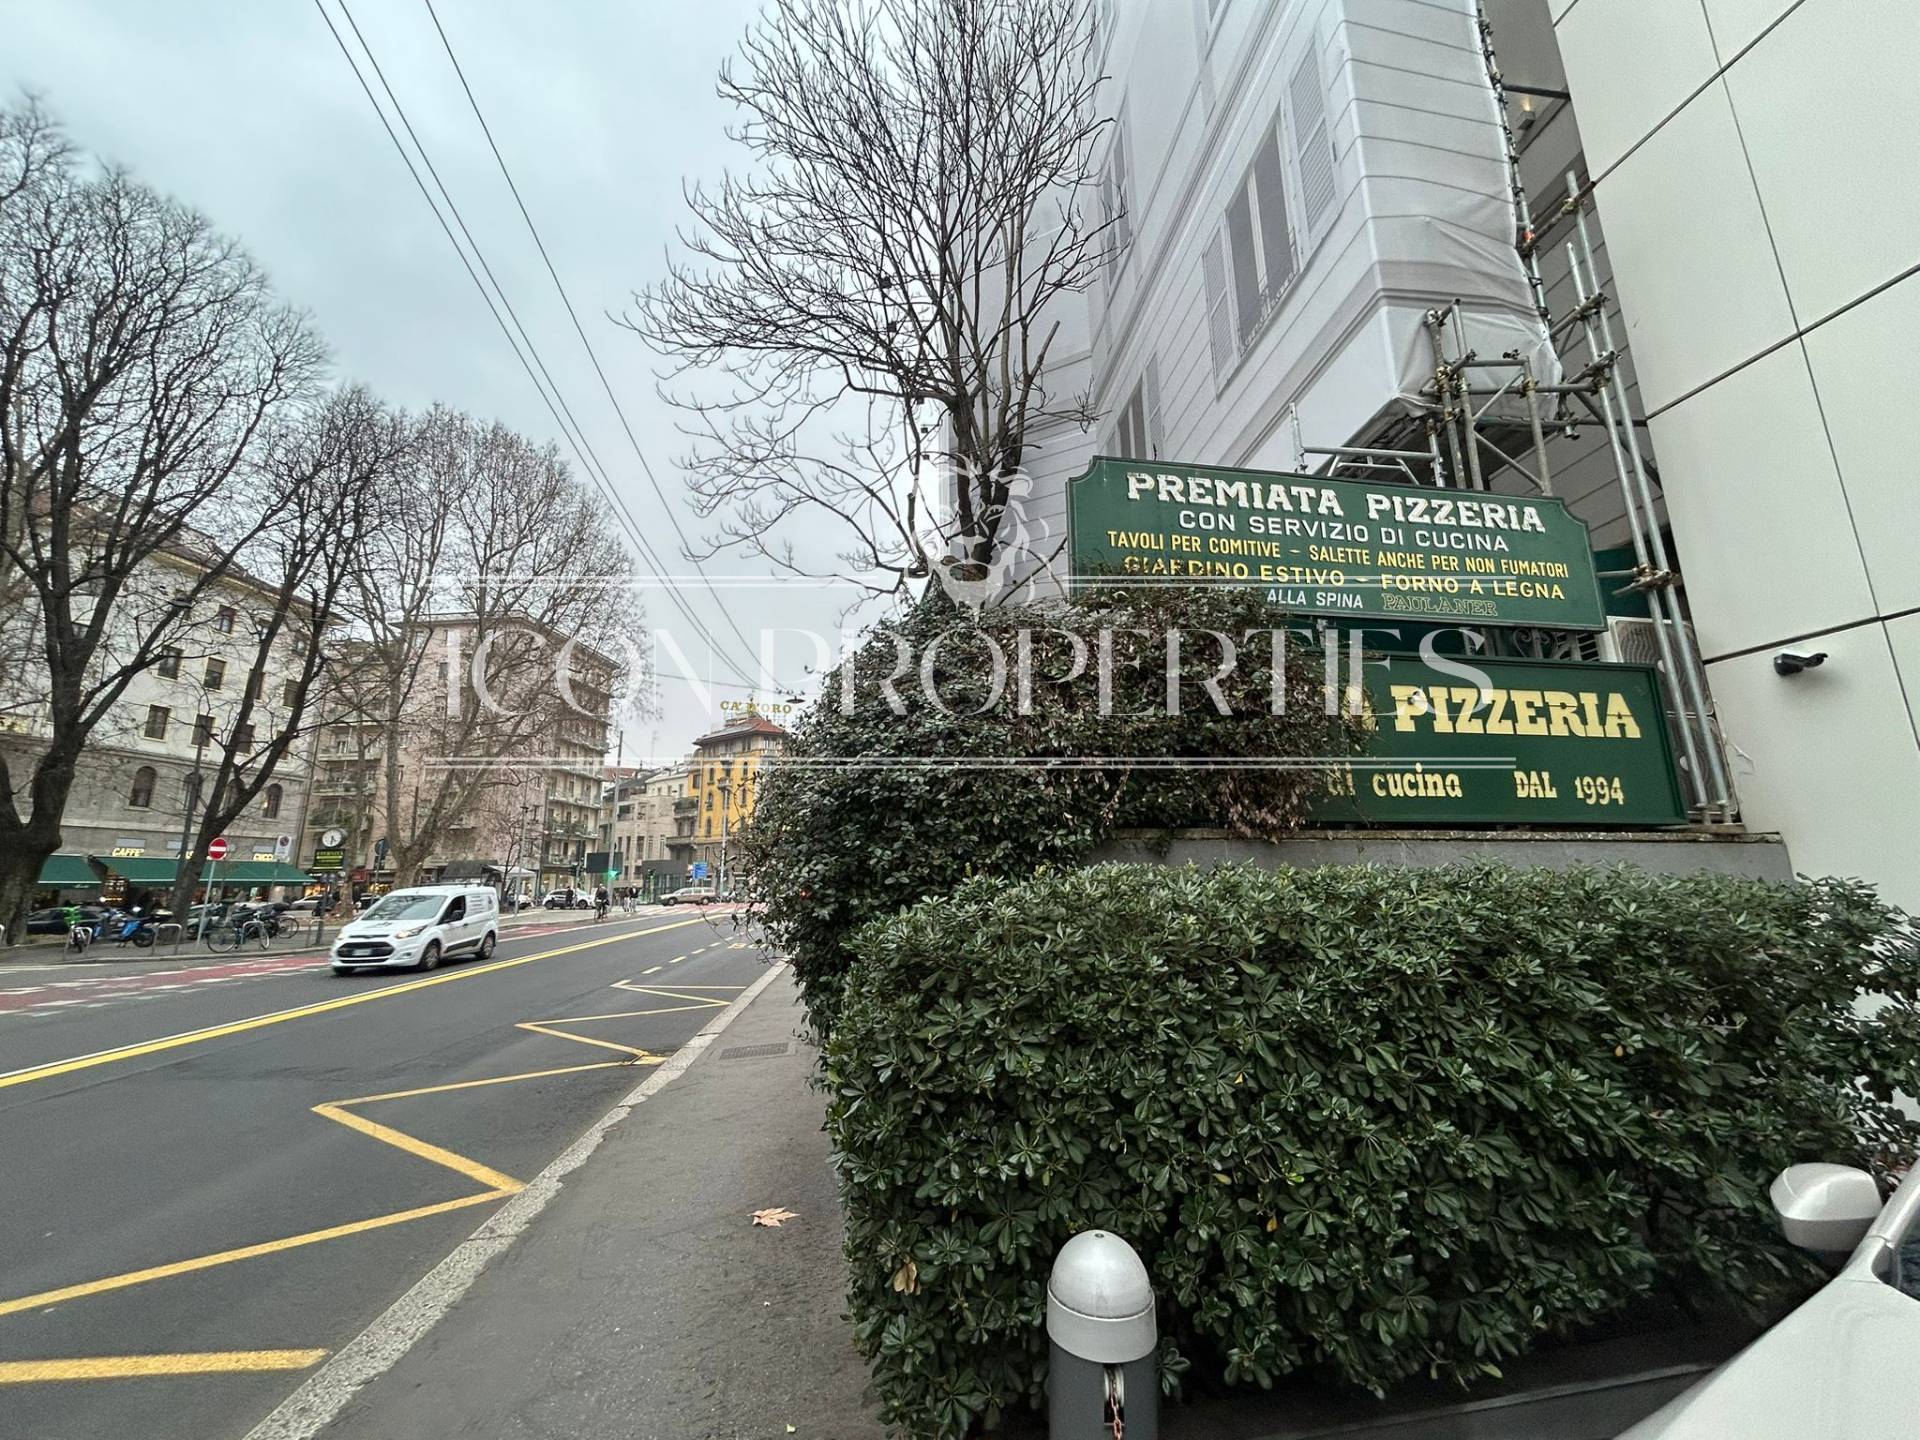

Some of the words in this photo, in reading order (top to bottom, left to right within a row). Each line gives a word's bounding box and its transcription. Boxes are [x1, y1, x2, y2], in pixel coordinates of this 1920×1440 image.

[1126, 471, 1345, 517] PREMIATA
[1365, 493, 1546, 534] PIZZERIA
[1178, 510, 1236, 532] CON
[1249, 515, 1369, 543] SERVIZIO
[1380, 527, 1404, 546] DI
[1415, 530, 1510, 552] CUCINA
[1107, 530, 1164, 550] TAVOLI
[1171, 534, 1202, 552] PER
[1208, 537, 1281, 558] COMITIVE
[1309, 545, 1370, 565] SALETTE
[1377, 550, 1425, 570] ANCHE
[1431, 554, 1460, 572] PER
[1465, 557, 1495, 574] NON
[1501, 558, 1569, 578] FUMATORI
[1260, 565, 1345, 587] ESTIVO
[1380, 573, 1459, 594] FORNO
[1469, 580, 1484, 595] A
[1493, 579, 1565, 600] LEGNA
[1266, 588, 1307, 605] ALLA
[1315, 591, 1363, 609] SPINA
[1382, 592, 1498, 617] PAULANER
[1390, 684, 1642, 739] PIZZERIA
[1372, 762, 1463, 798] cucina
[1513, 770, 1558, 799] DAL
[1574, 775, 1624, 806] 1994
